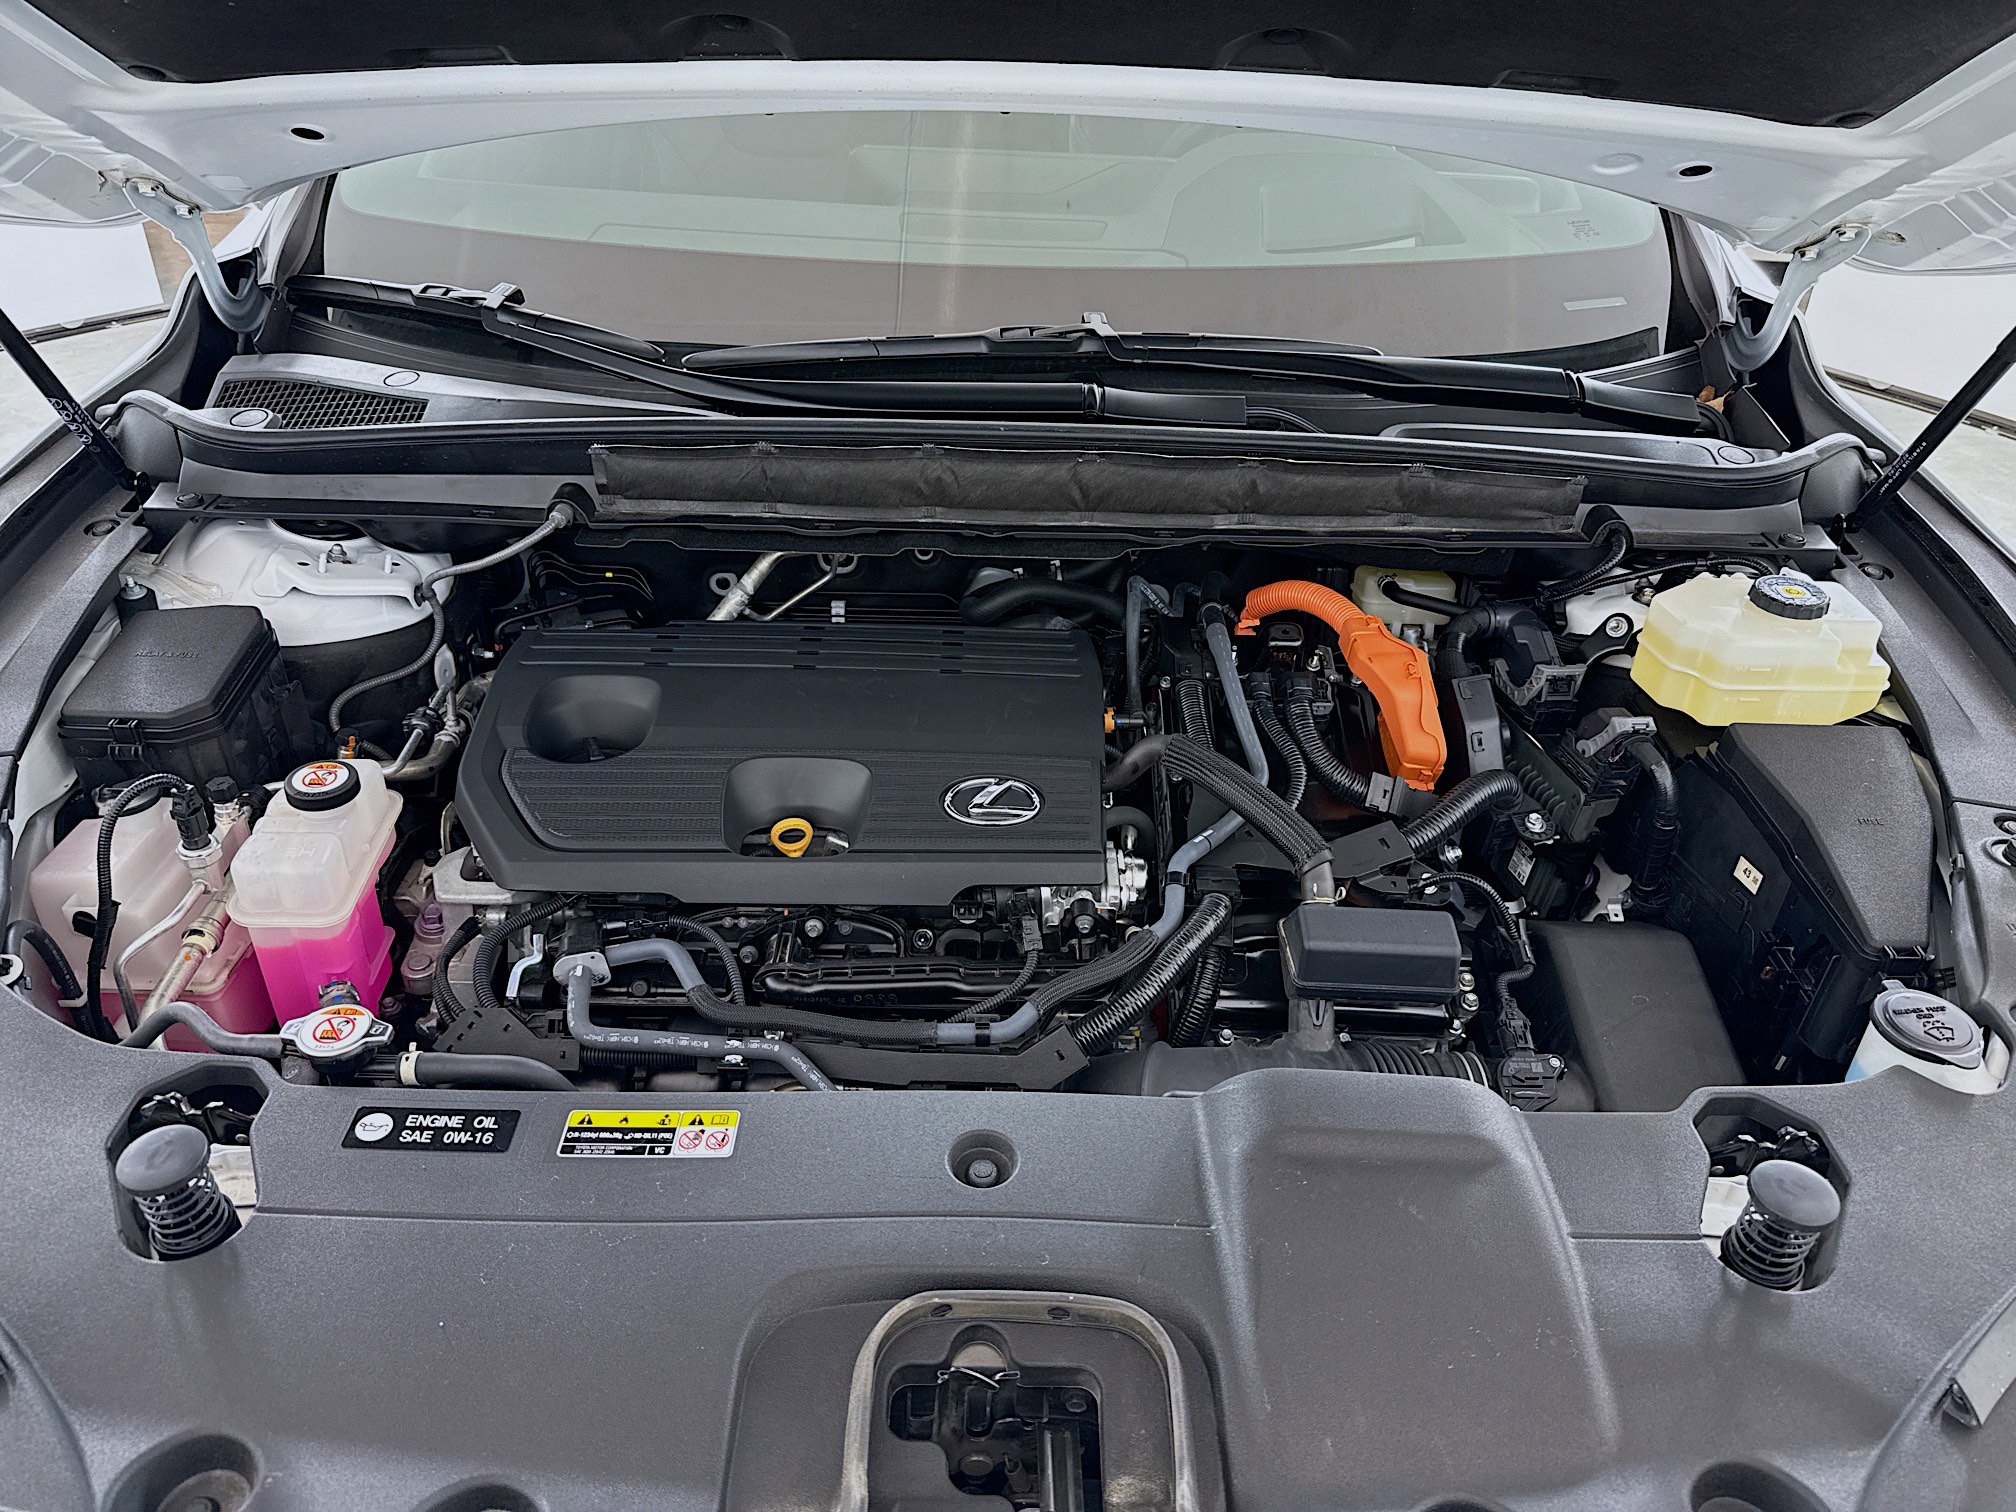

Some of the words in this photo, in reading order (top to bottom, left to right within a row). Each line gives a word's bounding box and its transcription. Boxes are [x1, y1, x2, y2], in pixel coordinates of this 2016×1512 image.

[1743, 867, 1751, 879] 43
[405, 1114, 465, 1128] ENGINE
[473, 1115, 499, 1129] OIL
[399, 1129, 434, 1143] SAE
[443, 1131, 494, 1144] 0W-16
